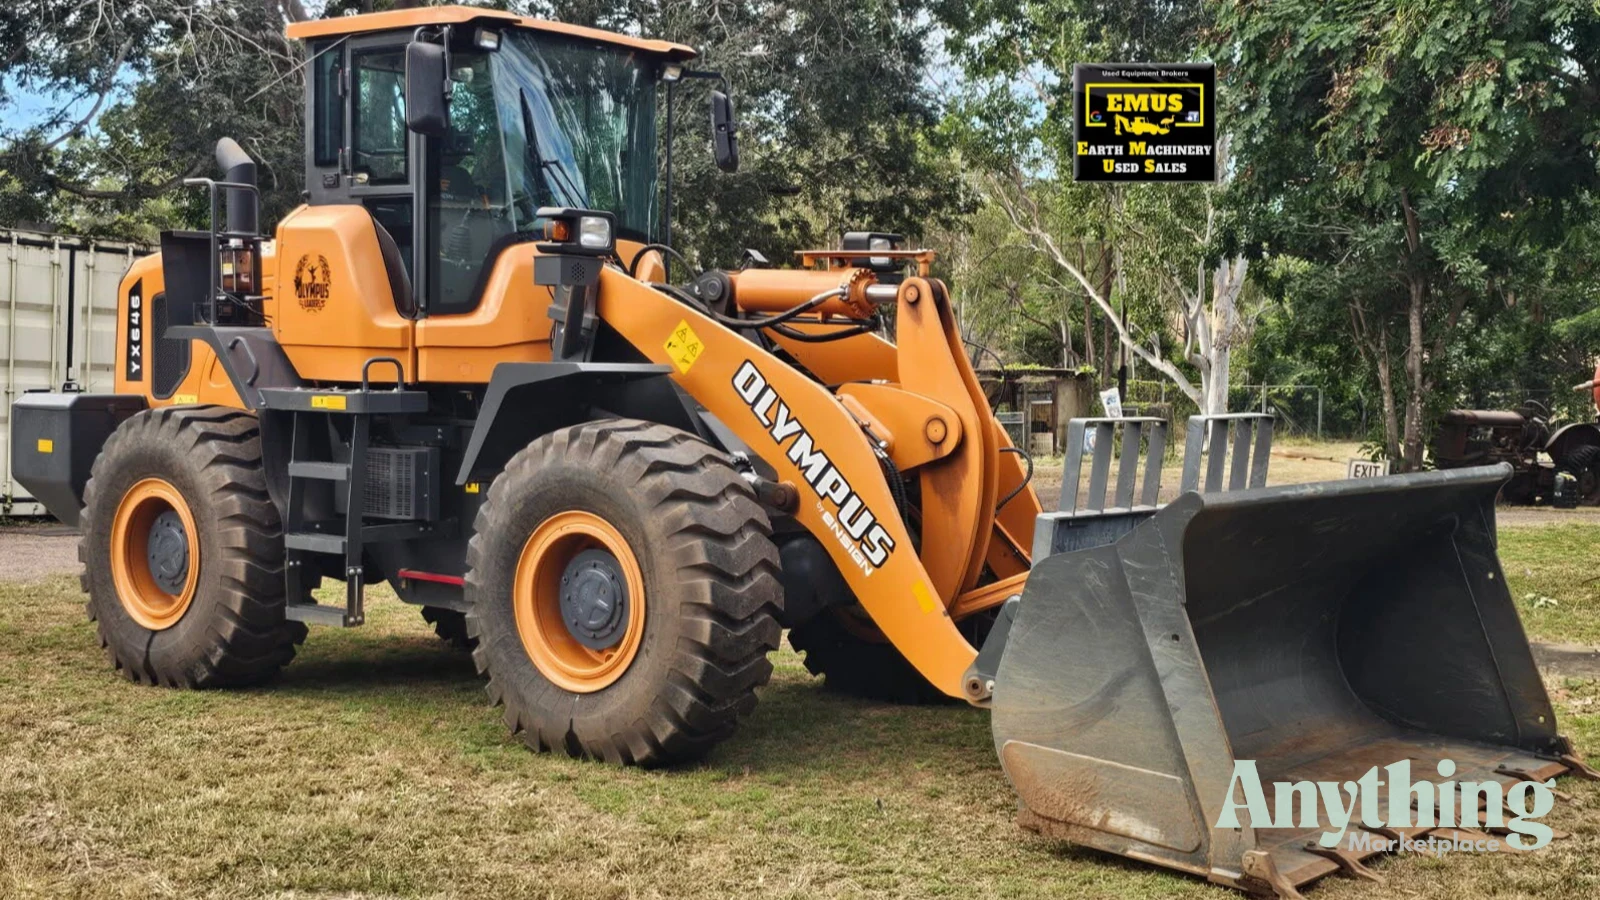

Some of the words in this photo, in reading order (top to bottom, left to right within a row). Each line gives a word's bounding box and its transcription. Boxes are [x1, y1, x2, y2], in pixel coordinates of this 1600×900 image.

[298, 282, 329, 299] OLYMPUS
[731, 359, 896, 569] OLYMPUS
[1354, 464, 1381, 478] EXIT
[822, 511, 873, 577] ENSIGN
